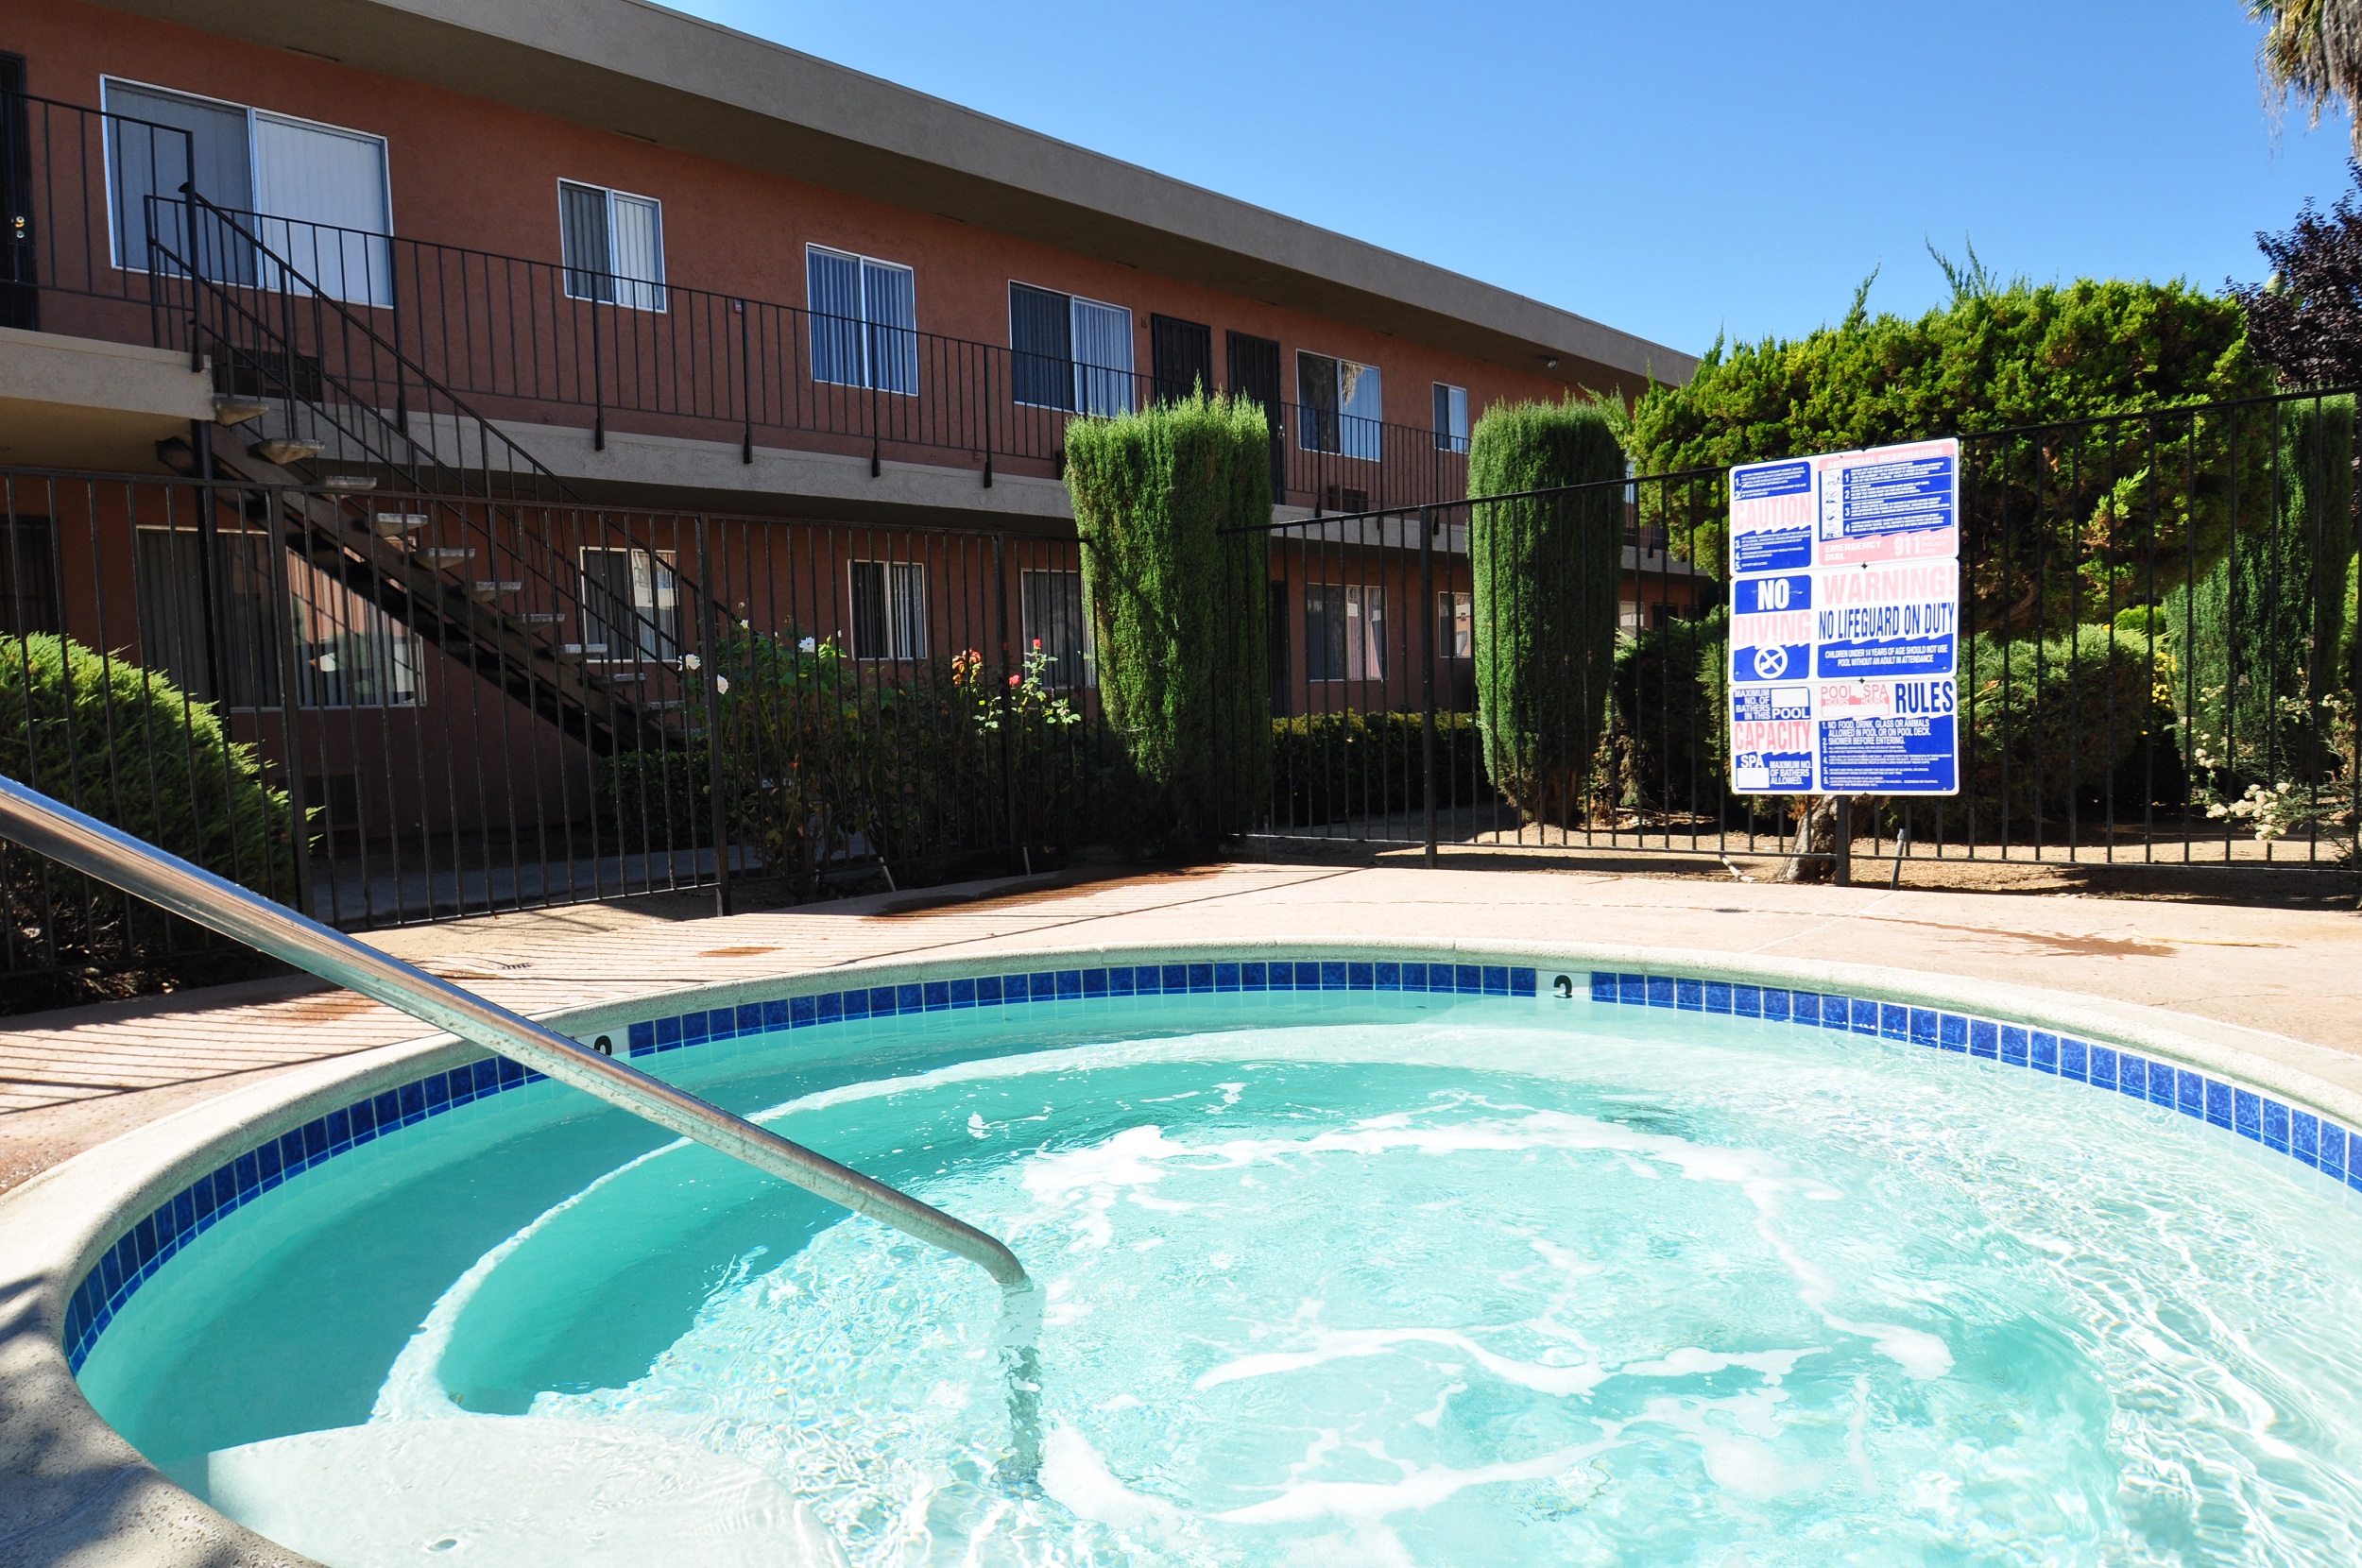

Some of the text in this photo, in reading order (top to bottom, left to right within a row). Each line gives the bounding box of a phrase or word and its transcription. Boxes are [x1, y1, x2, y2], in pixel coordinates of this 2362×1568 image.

[1826, 448, 1943, 469] ARTIFICIAL RESPIRATION
[1844, 473, 1850, 482] 1
[1844, 490, 1850, 499] 2
[1734, 494, 1811, 529] CAUTION
[1844, 507, 1850, 517] 3
[1844, 524, 1850, 533] 4
[1824, 540, 1882, 554] EMERGENCY
[1893, 535, 1921, 556] 911
[1824, 553, 1845, 562] DIAL
[1823, 565, 1955, 605] WARNING!
[1757, 578, 1789, 610] NO
[1819, 602, 1955, 639] NO LIFEGUARD ON DUTY
[1734, 611, 1811, 644] DIVING
[1824, 649, 1849, 659] CHILDREN
[1849, 648, 1865, 657] UNDER
[1871, 647, 1887, 656] YEARS
[1888, 647, 1894, 656] OF
[1895, 646, 1906, 656] AGE
[1906, 645, 1926, 655] SHOULD
[1926, 644, 1937, 654] NOT
[1938, 644, 1948, 653] USE
[1838, 658, 1851, 667] POOL
[1851, 657, 1873, 666] WITHOUT
[1873, 656, 1880, 665] AN
[1880, 656, 1895, 665] ADULT
[1902, 655, 1934, 664] ATTENDANCE
[1734, 689, 1770, 697] MAXIMUM
[1821, 681, 1954, 714] POOL SPA RULES
[1758, 696, 1771, 705] OF
[1736, 704, 1771, 712] BATHERS
[1772, 707, 1810, 719] POOL
[1754, 711, 1771, 720] THIS
[1875, 720, 1895, 728] GLASS
[1895, 719, 1904, 727] OR
[1904, 718, 1929, 727] ANIMALS
[1734, 721, 1811, 750] CAPACITY
[1828, 728, 1855, 737] ALLOWED
[1856, 728, 1862, 737] IN
[1862, 728, 1878, 737] POOL
[1878, 727, 1888, 736] OR
[1888, 727, 1896, 736] ON
[1897, 727, 1913, 736] POOL
[1828, 737, 1853, 745] SHOWER
[1853, 737, 1875, 745] BEFORE
[1740, 754, 1765, 768] SPA
[1769, 760, 1812, 769] MAXIMUM NO.
[1770, 768, 1810, 777] OF BATHERS
[1770, 776, 1804, 785] ALLOWED.
